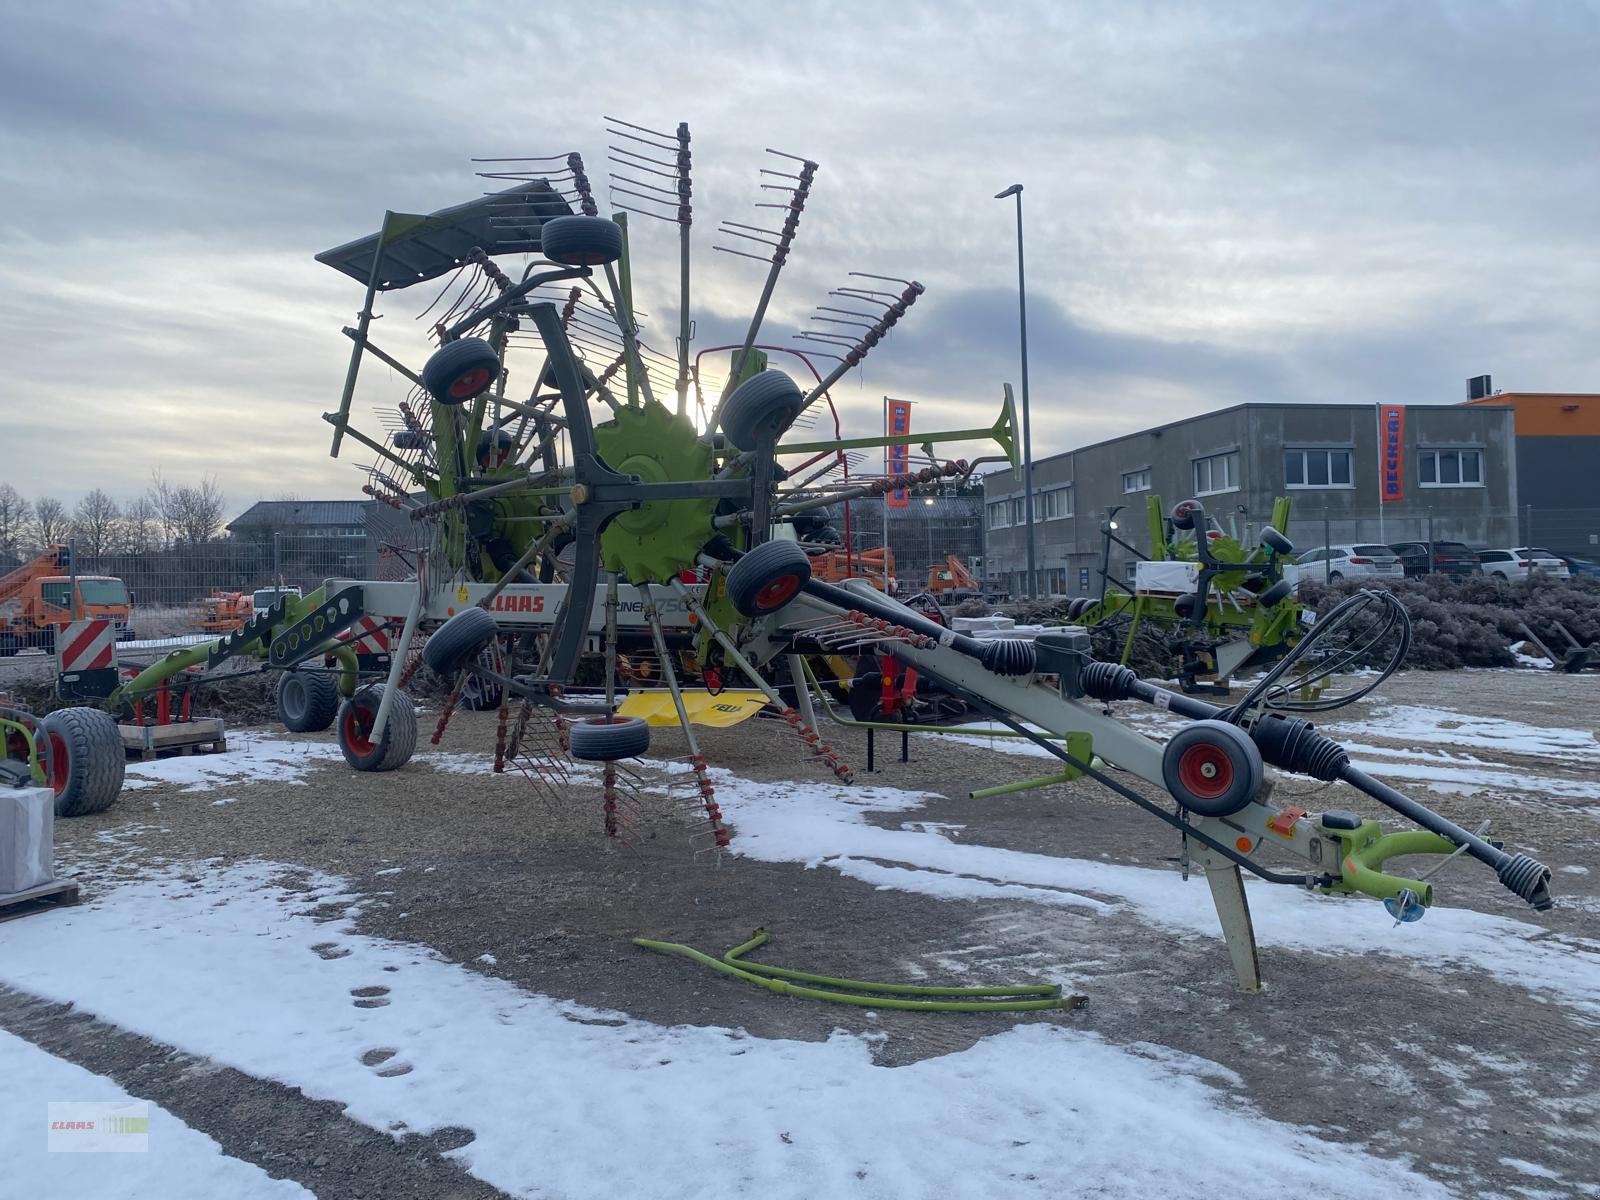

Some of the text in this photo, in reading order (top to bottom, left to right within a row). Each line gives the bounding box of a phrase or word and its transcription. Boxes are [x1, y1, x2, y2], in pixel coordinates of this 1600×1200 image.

[894, 418, 905, 499] BCKR
[1387, 420, 1399, 494] BECKER
[488, 595, 544, 612] LAAS
